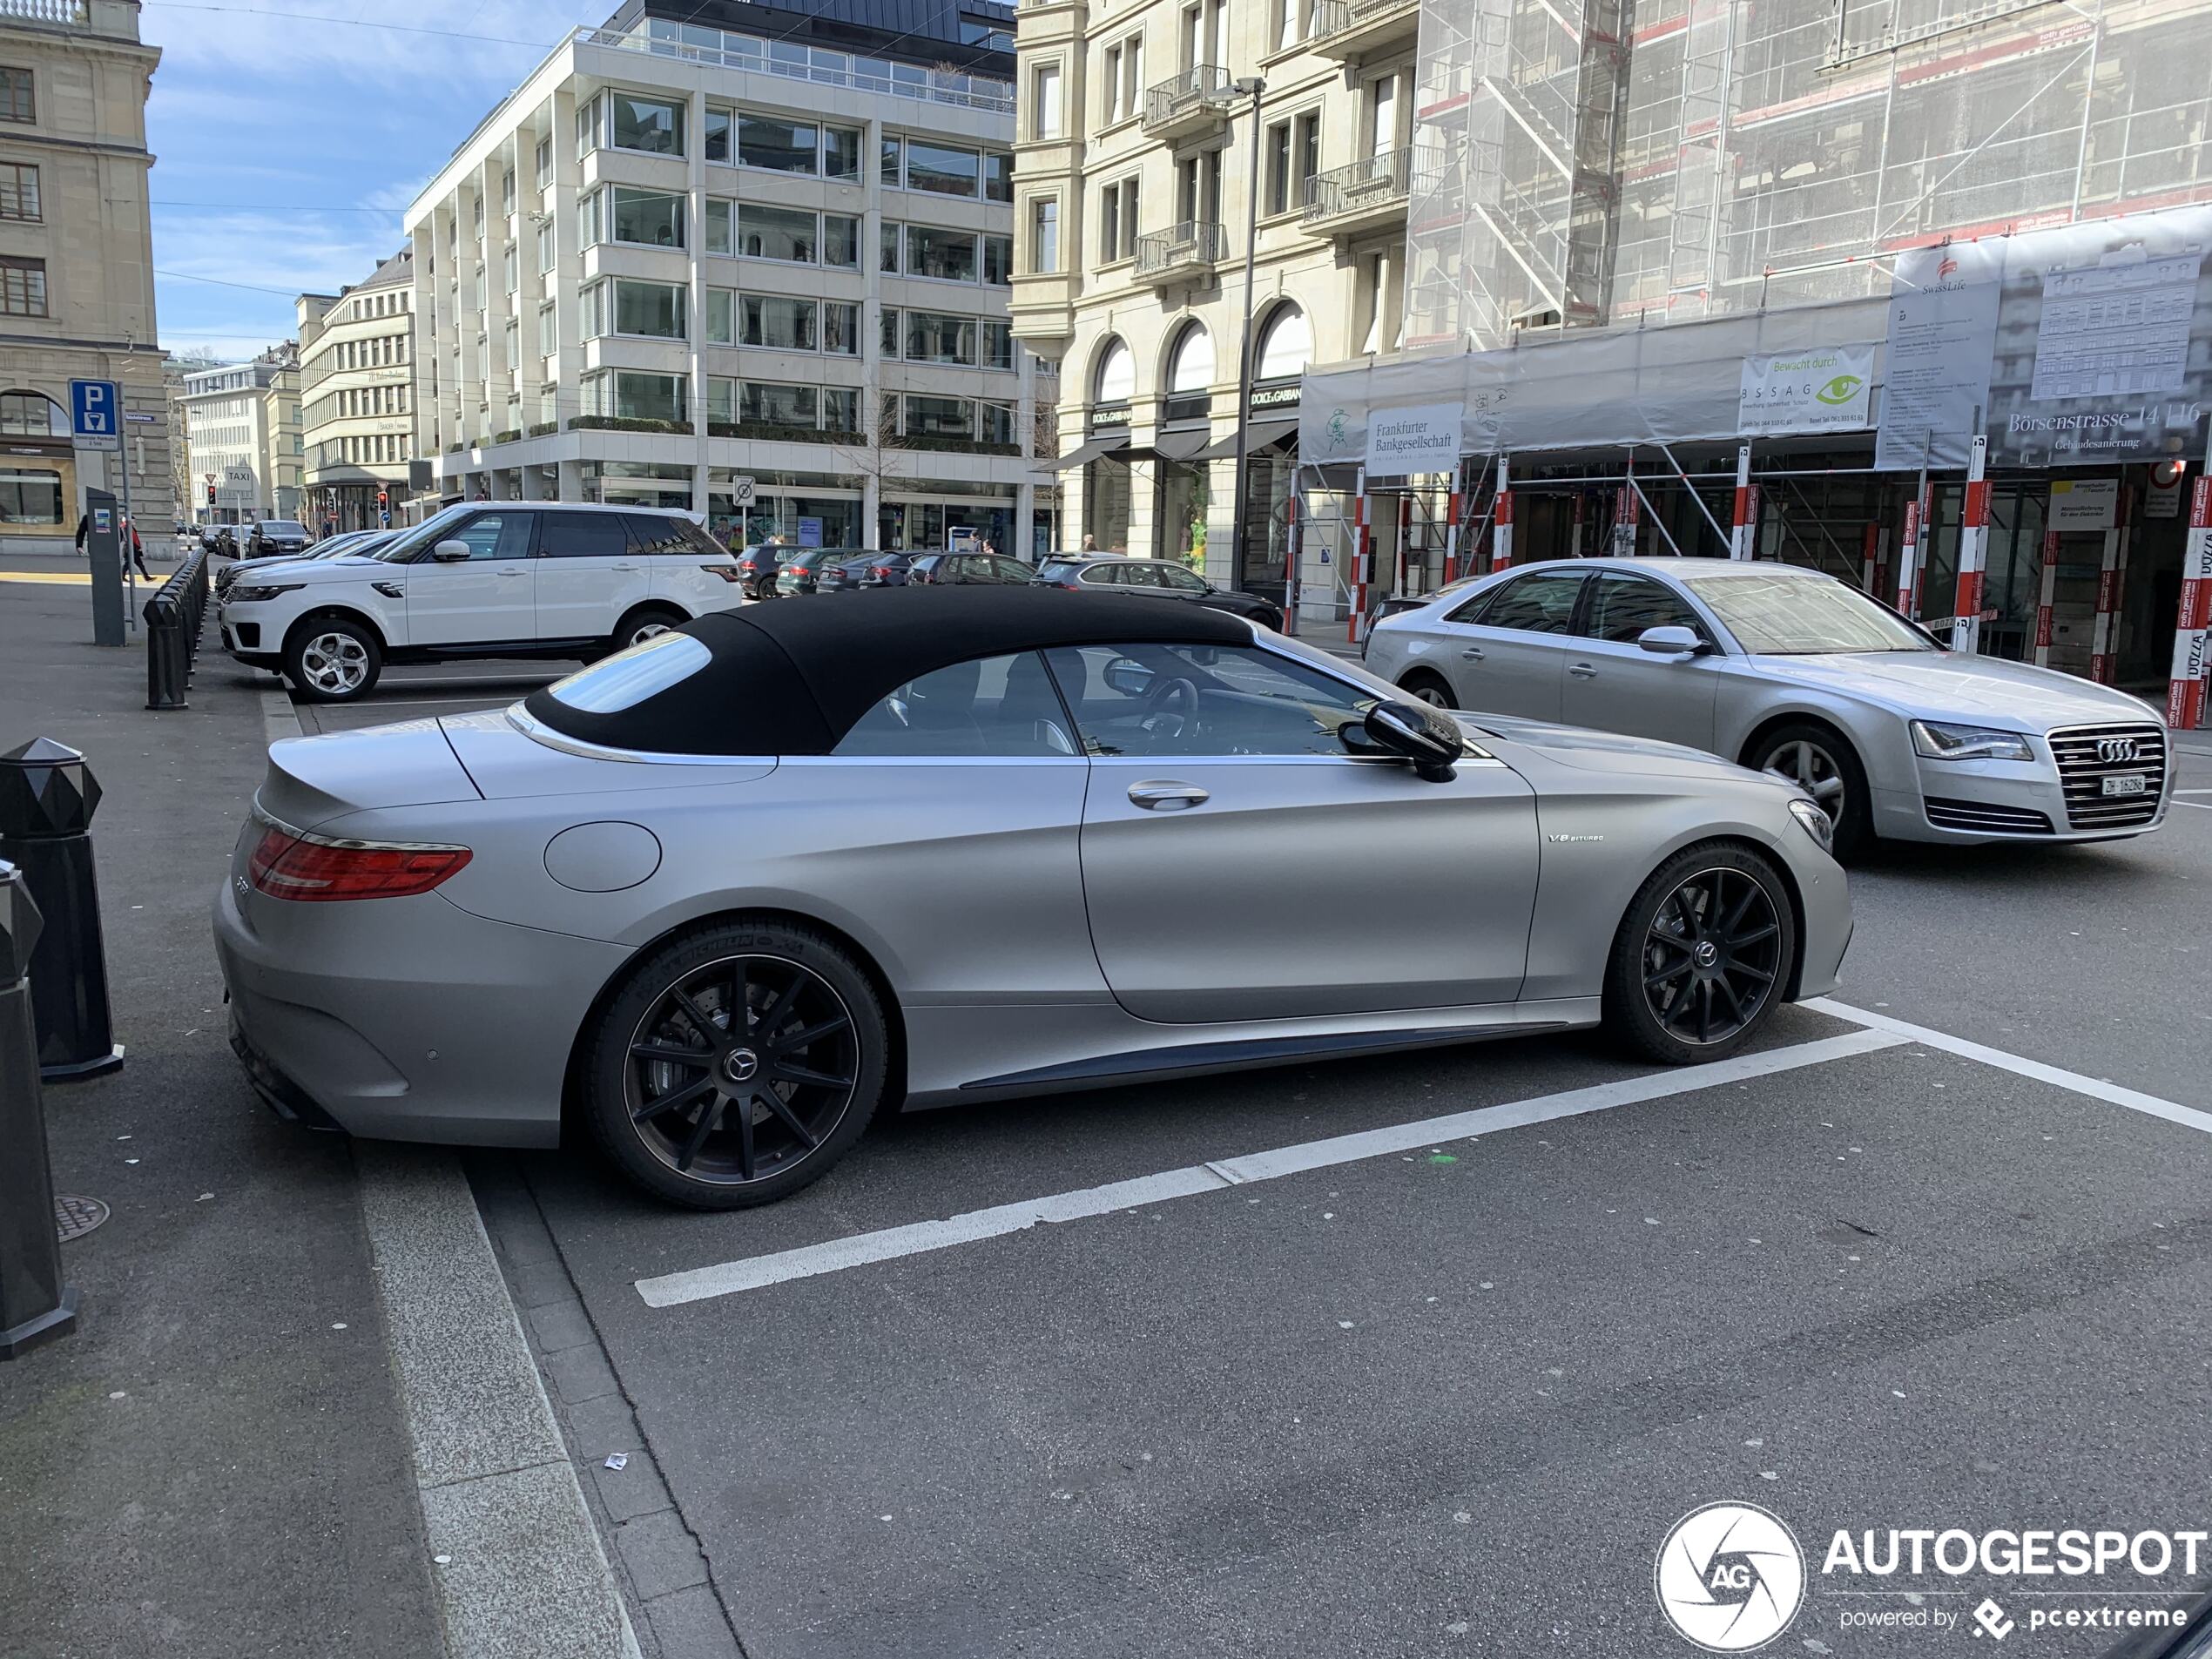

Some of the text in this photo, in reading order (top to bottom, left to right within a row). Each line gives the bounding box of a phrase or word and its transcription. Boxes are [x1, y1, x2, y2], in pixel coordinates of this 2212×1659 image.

[2040, 30, 2058, 41] roth
[1774, 355, 1838, 373] Bewacht durch
[84, 385, 104, 411] P
[2008, 412, 2130, 433] Börsenstrasse
[2138, 405, 2159, 425] 14
[2180, 401, 2202, 423] 16
[1376, 421, 1428, 437] Frankfurter
[1375, 433, 1452, 454] Bankgesellschaft
[2054, 438, 2141, 450] Gebäudesanierung
[229, 472, 250, 482] TAXI
[2195, 478, 2205, 509] gerüste
[2182, 581, 2192, 610] gerüste
[2168, 681, 2180, 727] roth gerüste
